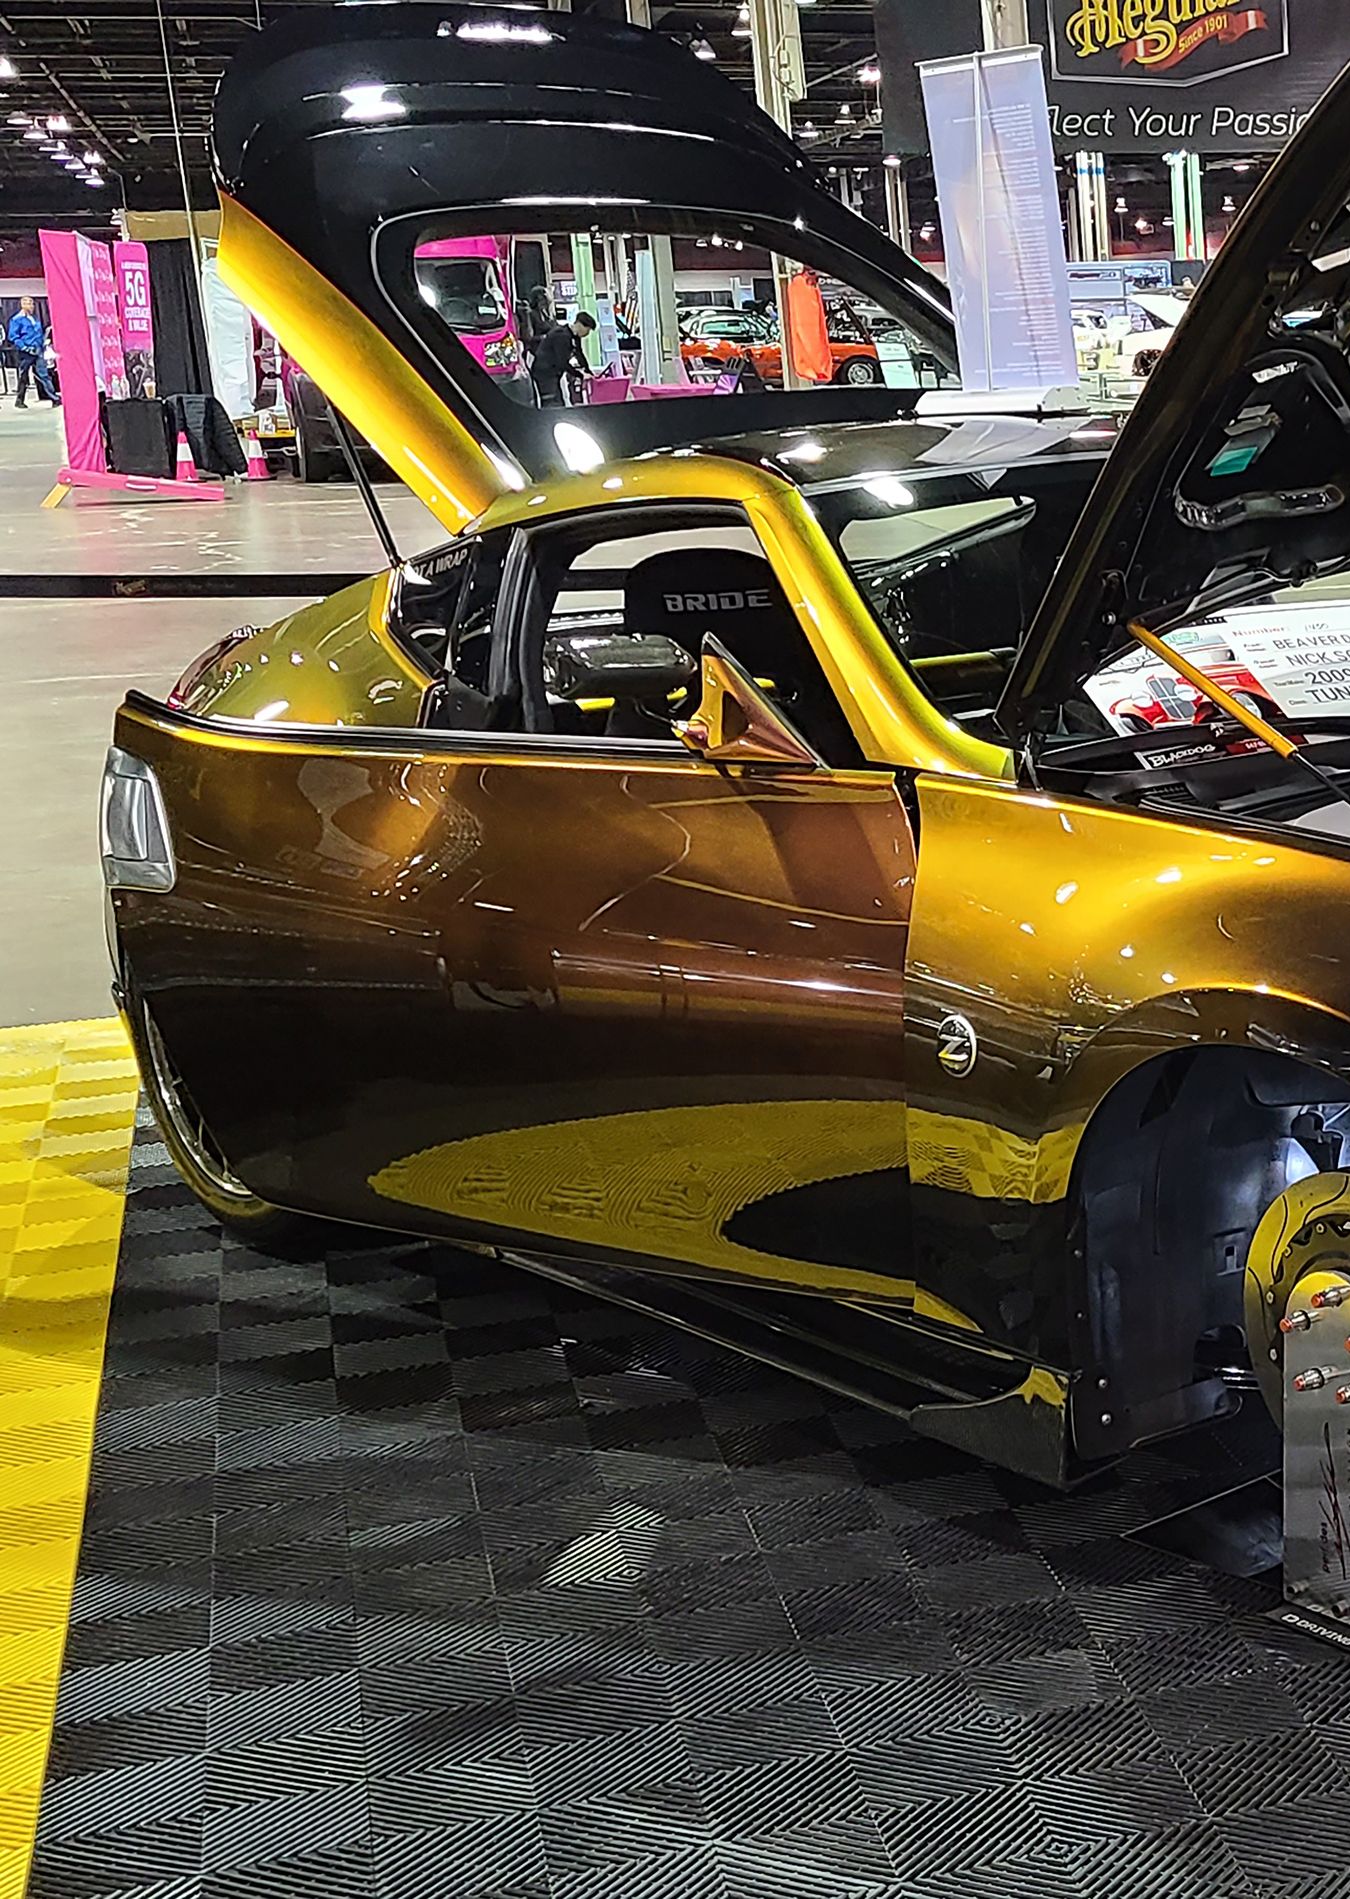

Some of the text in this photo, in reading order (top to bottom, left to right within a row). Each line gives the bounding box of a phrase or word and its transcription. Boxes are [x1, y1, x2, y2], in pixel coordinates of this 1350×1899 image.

[1178, 14, 1228, 54] Since 1901
[1047, 105, 1116, 137] lect
[1128, 106, 1202, 137] Your
[125, 271, 146, 306] 5G
[425, 560, 434, 577] A
[435, 548, 468, 574] WRAP
[663, 589, 773, 612] BRIDE
[1273, 632, 1341, 650] BEAVER
[1285, 650, 1333, 668] NICK
[1148, 743, 1217, 768] BLACKDOG
